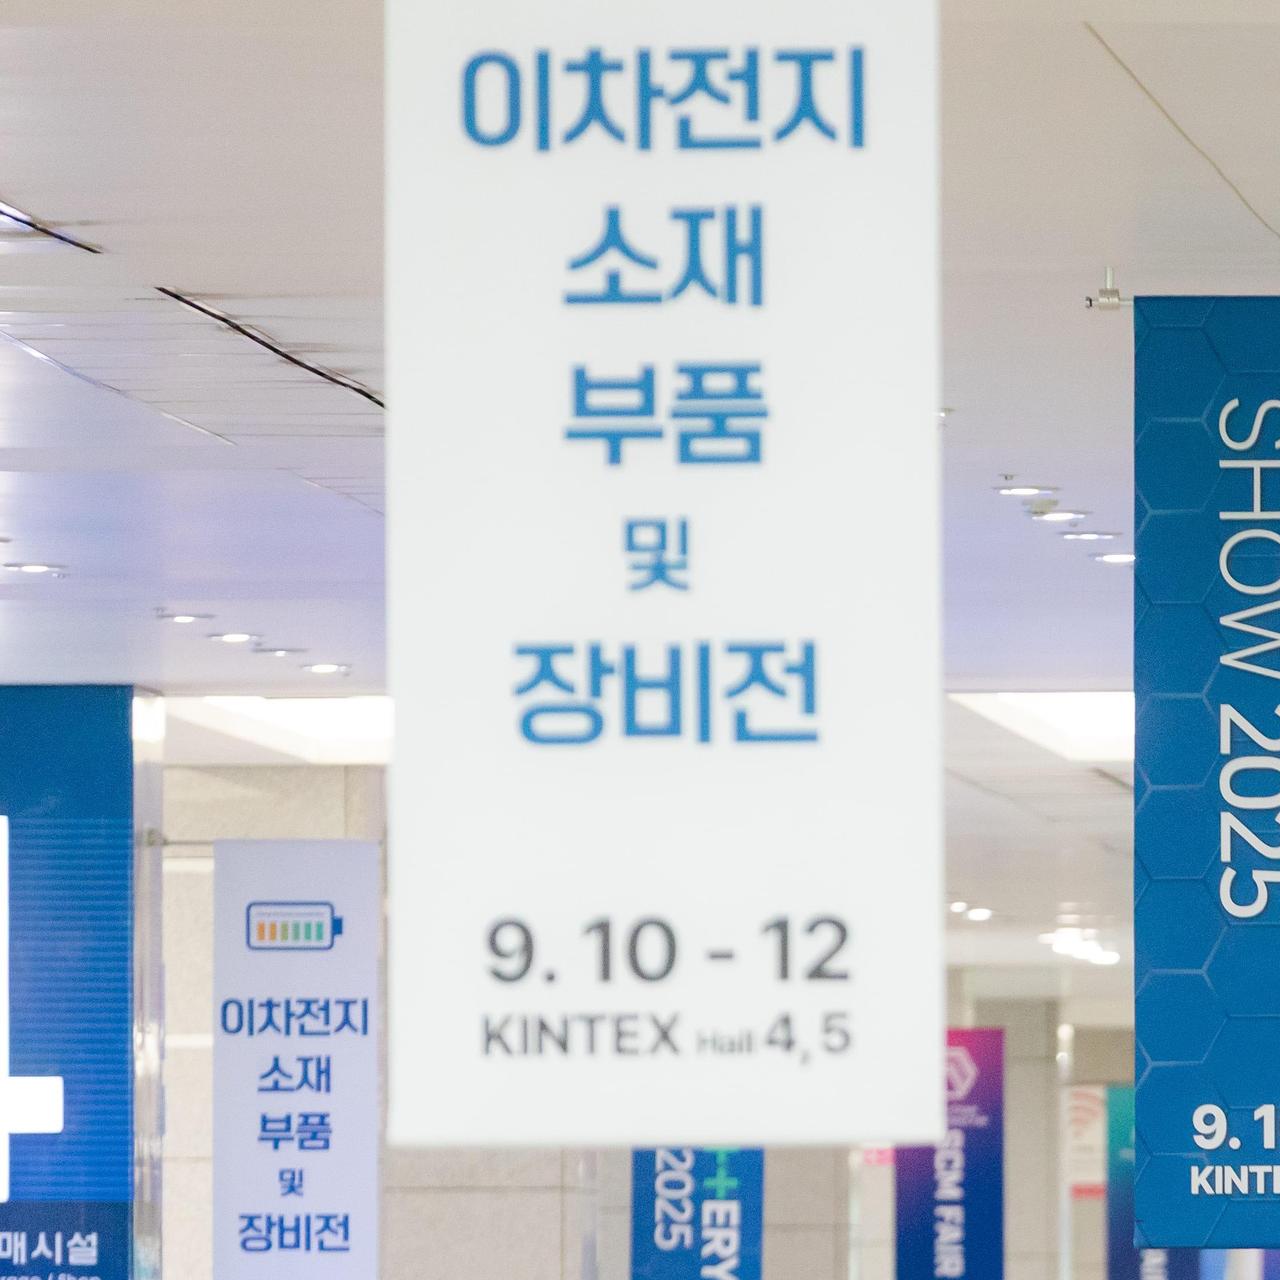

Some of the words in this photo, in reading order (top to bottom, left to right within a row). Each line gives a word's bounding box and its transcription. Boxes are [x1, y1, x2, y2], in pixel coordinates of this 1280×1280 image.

[459, 45, 867, 152] 이차전지
[564, 205, 765, 307] 소재
[564, 362, 770, 467] 부품
[625, 515, 691, 591] 및
[512, 639, 820, 745] 장비전
[221, 999, 369, 1037] 이차전지
[481, 1013, 681, 1057] KINTEX
[697, 1026, 755, 1056] Hall
[258, 1056, 332, 1095] 소재
[258, 1113, 332, 1151] 부품
[279, 1168, 304, 1197] 및
[654, 1147, 695, 1251] 2025
[238, 1213, 351, 1253] 장비전
